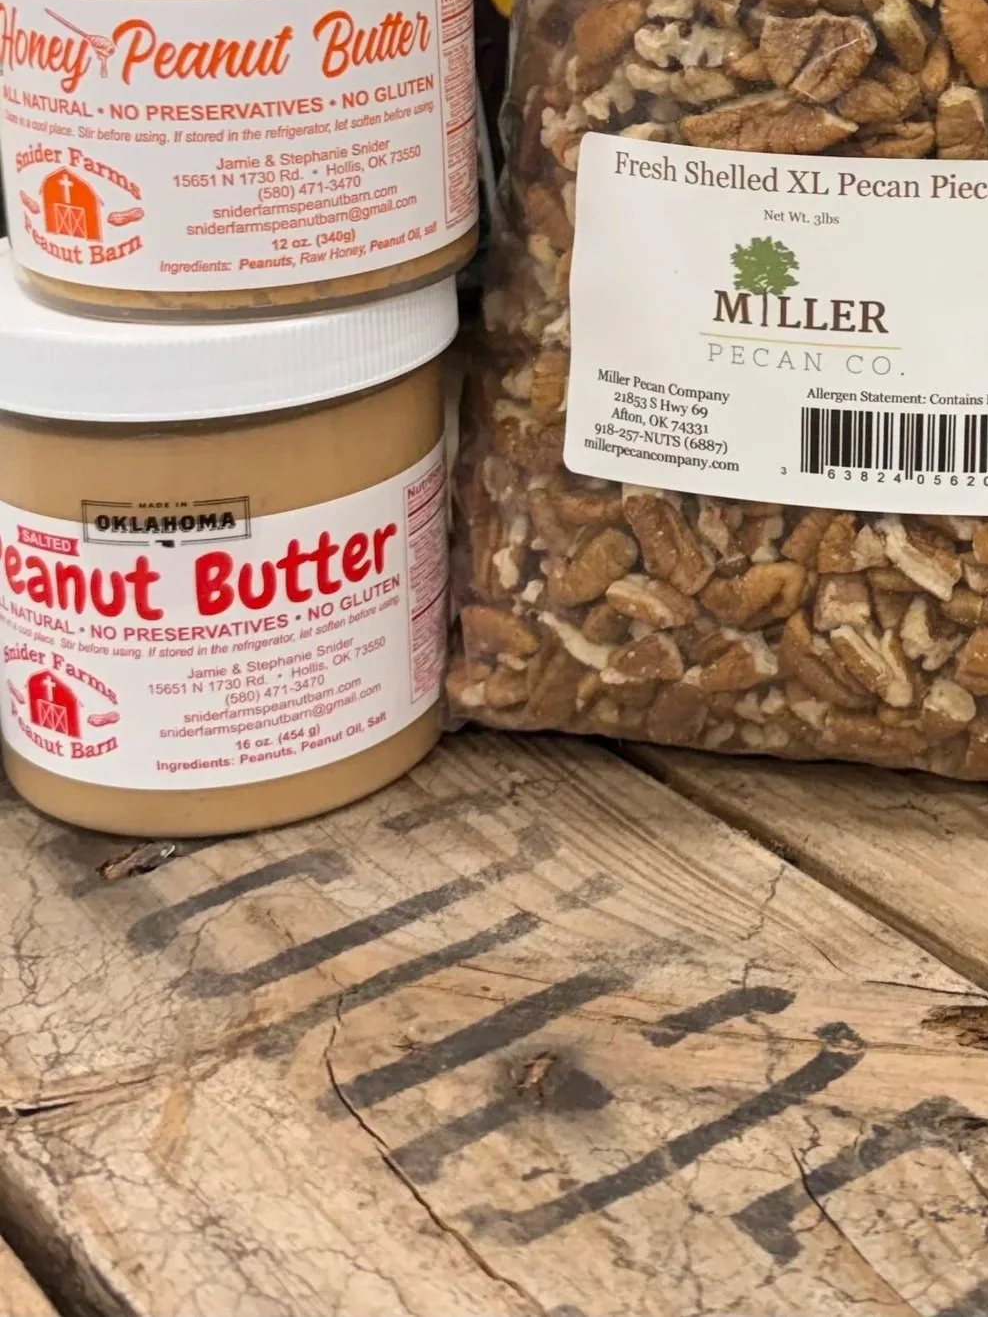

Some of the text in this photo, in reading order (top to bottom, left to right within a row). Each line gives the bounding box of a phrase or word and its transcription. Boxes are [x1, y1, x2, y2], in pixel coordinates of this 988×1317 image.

[112, 19, 294, 85] Peanut
[313, 10, 432, 79] Butter
[23, 92, 93, 117] NATURAL
[109, 104, 139, 120] NO
[145, 97, 323, 121] PRESERVATIVES
[342, 90, 369, 109] NO
[374, 75, 433, 102] GLUTEN
[16, 143, 142, 200] Snider Farms
[216, 140, 389, 170] Jamie & Stephanie Snider
[258, 175, 361, 202] (580) 471-3470
[615, 151, 677, 182] Fresh
[684, 160, 778, 192] Shelled
[786, 170, 829, 195] XL
[838, 172, 920, 198] Pecan
[764, 209, 839, 226] Net Wt. 3lbs
[89, 235, 143, 264] Barn
[272, 230, 356, 250] 12 oz. (340g)
[712, 290, 889, 334] MILLER
[707, 343, 907, 377] PECAN CO.
[598, 368, 729, 405] Miller Pecan Company
[807, 387, 857, 403] Allergen
[860, 390, 926, 404] Statement:
[929, 394, 983, 405] Contains
[611, 407, 708, 435] Afton, OK 74331
[614, 391, 708, 418] 21853 S Hwy 69
[584, 437, 739, 471] millerpecancompany.com
[594, 423, 727, 455] 918-257-NUTS (6887)
[95, 511, 236, 534] OKLAHOMA
[22, 530, 72, 551] SALTED
[0, 523, 398, 621] eanut Butter
[8, 606, 75, 634] NATURAL
[90, 624, 117, 640] NO
[123, 614, 289, 641] PRESERVATIVES
[307, 602, 334, 621] NO
[339, 576, 399, 610] GLUTEN
[52, 652, 118, 705] Farms
[148, 683, 186, 694] 15651
[192, 681, 203, 693] N
[208, 677, 241, 691] 1730
[290, 661, 328, 678] Hollis,
[332, 651, 351, 666] OK
[355, 638, 385, 658] 73550
[70, 737, 118, 759] Barn
[156, 711, 386, 773] Ingredients: Peanuts, Peanut Oil, Salt
